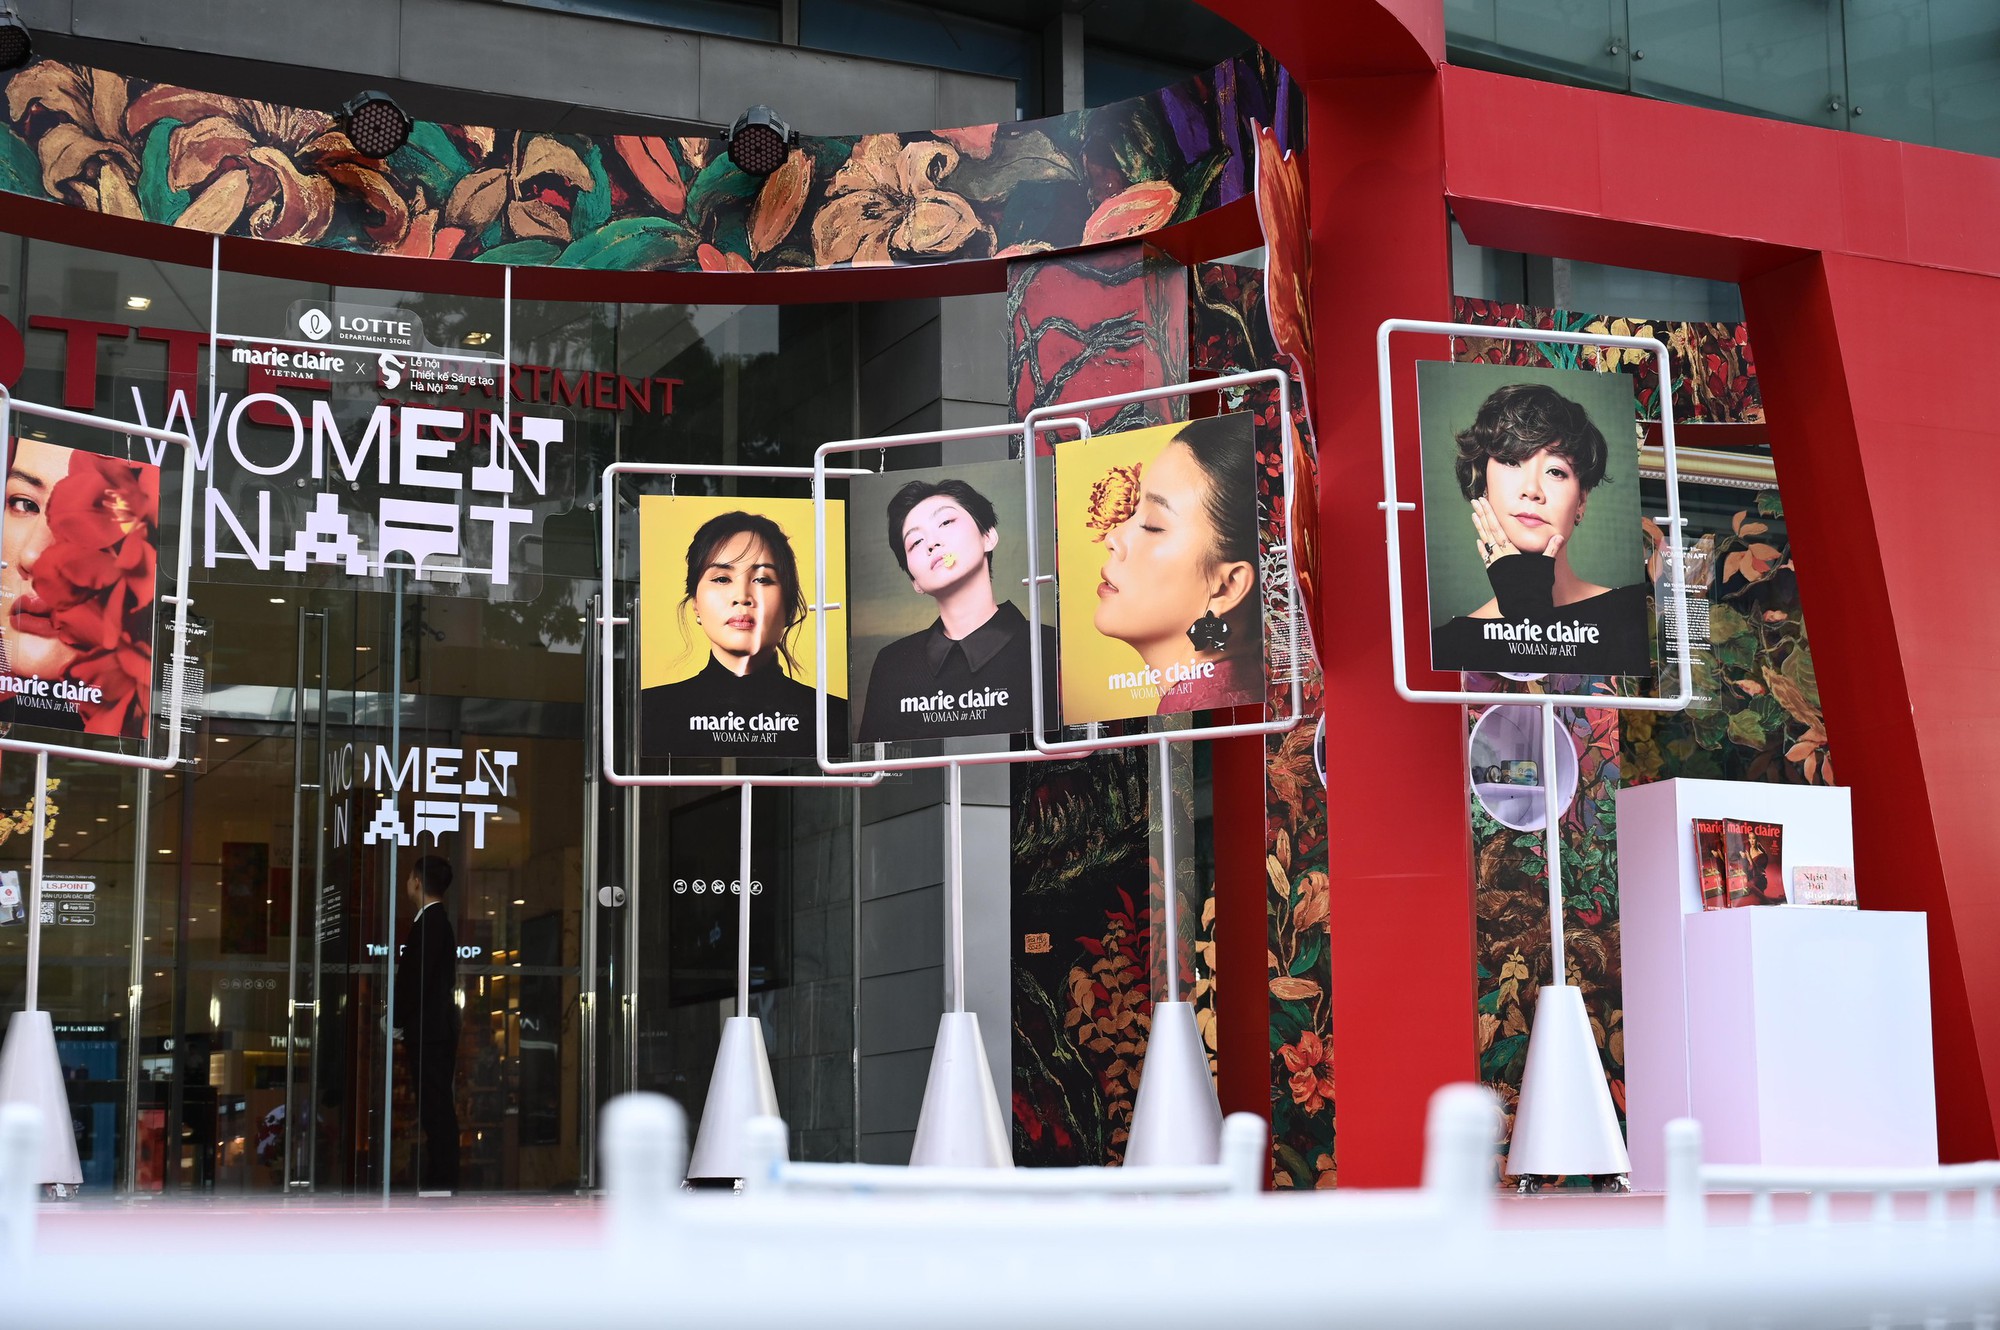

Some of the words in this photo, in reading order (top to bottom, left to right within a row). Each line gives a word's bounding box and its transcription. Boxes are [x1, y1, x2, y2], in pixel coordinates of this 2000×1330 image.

[339, 315, 412, 336] LOTTE
[339, 332, 387, 344] DEPARTMENT
[389, 337, 411, 346] STORE
[232, 346, 290, 368] marie
[292, 350, 345, 373] claire
[424, 357, 440, 369] hội
[0, 313, 332, 431] TTE
[264, 368, 314, 380] VIETNAM
[410, 369, 435, 380] Thiết
[437, 370, 449, 382] kế
[451, 372, 477, 386] Sáng
[478, 375, 495, 387] tạo
[410, 380, 425, 392] Hà
[429, 382, 444, 394] Nội
[131, 385, 564, 496] WOMEN
[284, 492, 534, 585] ART
[1483, 618, 1543, 641] marie
[1546, 620, 1600, 644] claire
[1508, 642, 1548, 656] WOMAN
[1549, 644, 1558, 656] in
[1558, 644, 1578, 657] ART
[1108, 664, 1162, 690] marie
[1165, 658, 1215, 683] claire
[0, 674, 49, 697] marie
[52, 680, 103, 704] claire
[1130, 685, 1167, 700] WOMAN
[1176, 682, 1194, 695] ART
[16, 695, 53, 710] WOMAN
[53, 700, 62, 711] in
[62, 702, 80, 713] ART
[900, 689, 955, 713] marie
[958, 686, 1010, 709] claire
[689, 711, 746, 730] marie
[749, 711, 800, 731] claire
[922, 711, 959, 723] WOMAN
[960, 711, 968, 721] in
[969, 709, 987, 720] ART
[712, 732, 750, 742] WOMAN
[751, 733, 759, 742] in
[759, 732, 778, 743] ART
[363, 798, 498, 850] ART
[1727, 821, 1753, 835] marie
[1754, 824, 1781, 838] claire
[46, 882, 89, 891] LS.POINT
